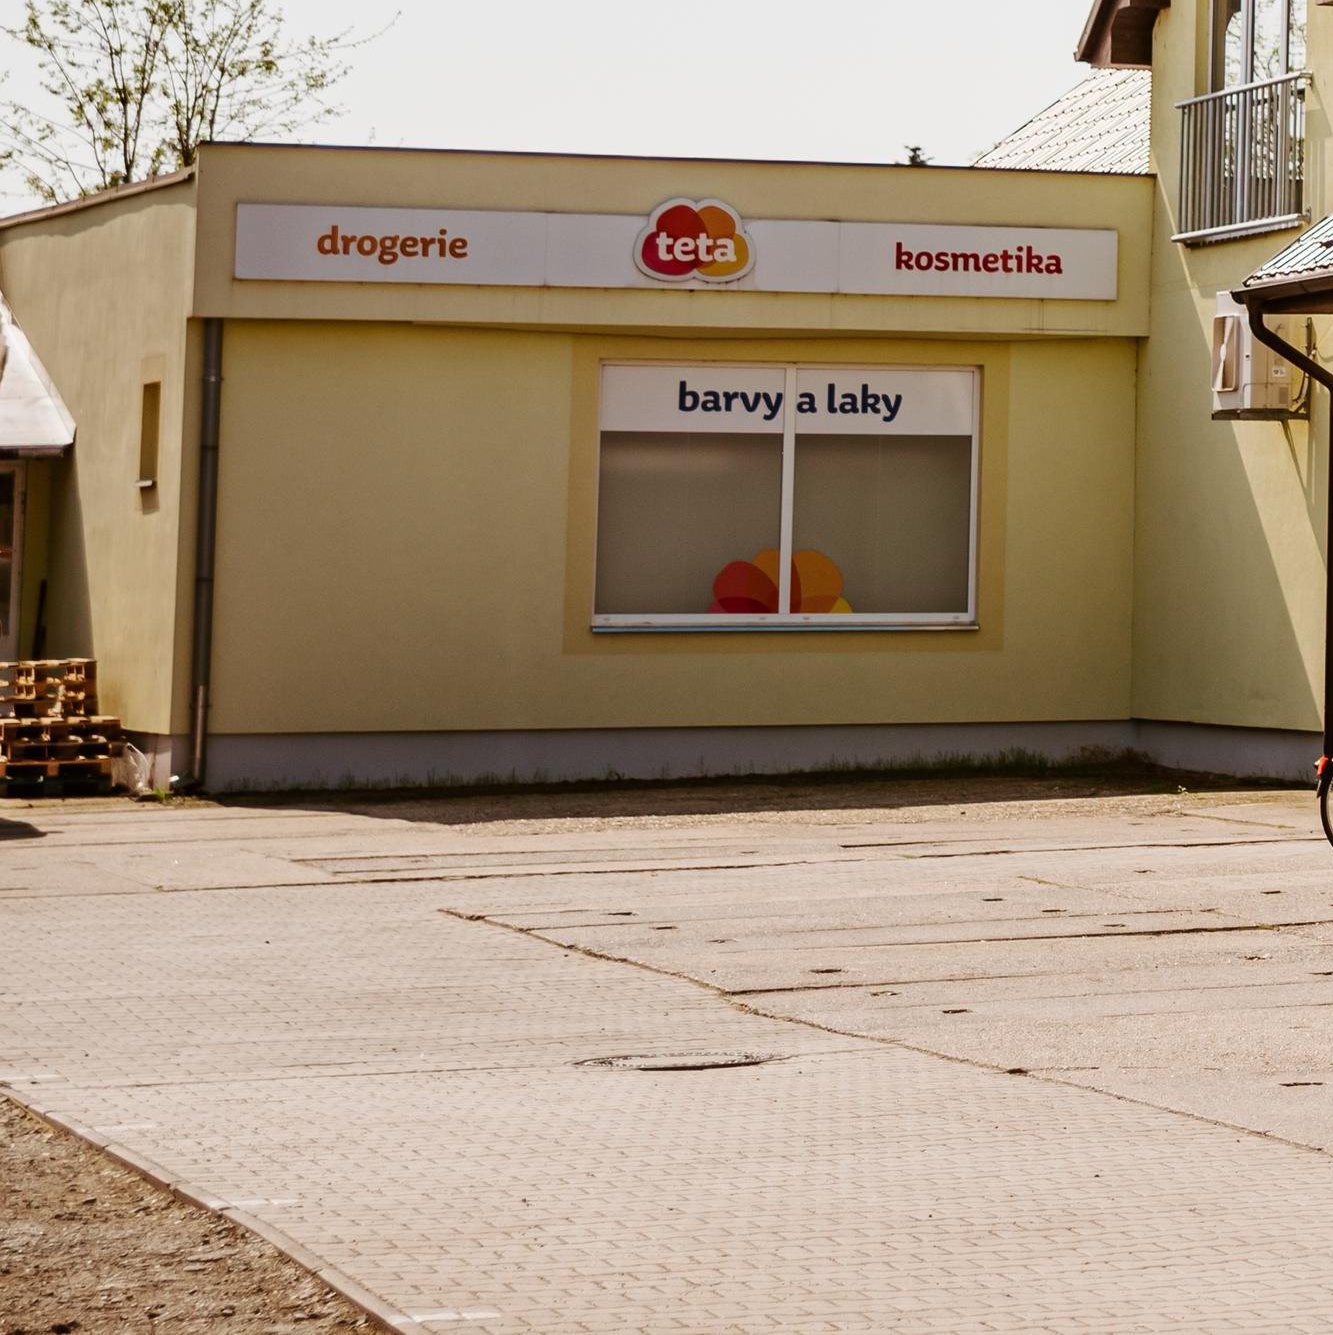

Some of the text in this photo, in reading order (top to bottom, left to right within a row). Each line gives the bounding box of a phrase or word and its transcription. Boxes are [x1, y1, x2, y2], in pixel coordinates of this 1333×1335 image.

[316, 224, 468, 266] drogerie
[656, 232, 737, 262] teta
[895, 241, 1063, 275] kosmetika
[678, 380, 903, 423] barvy a laky
